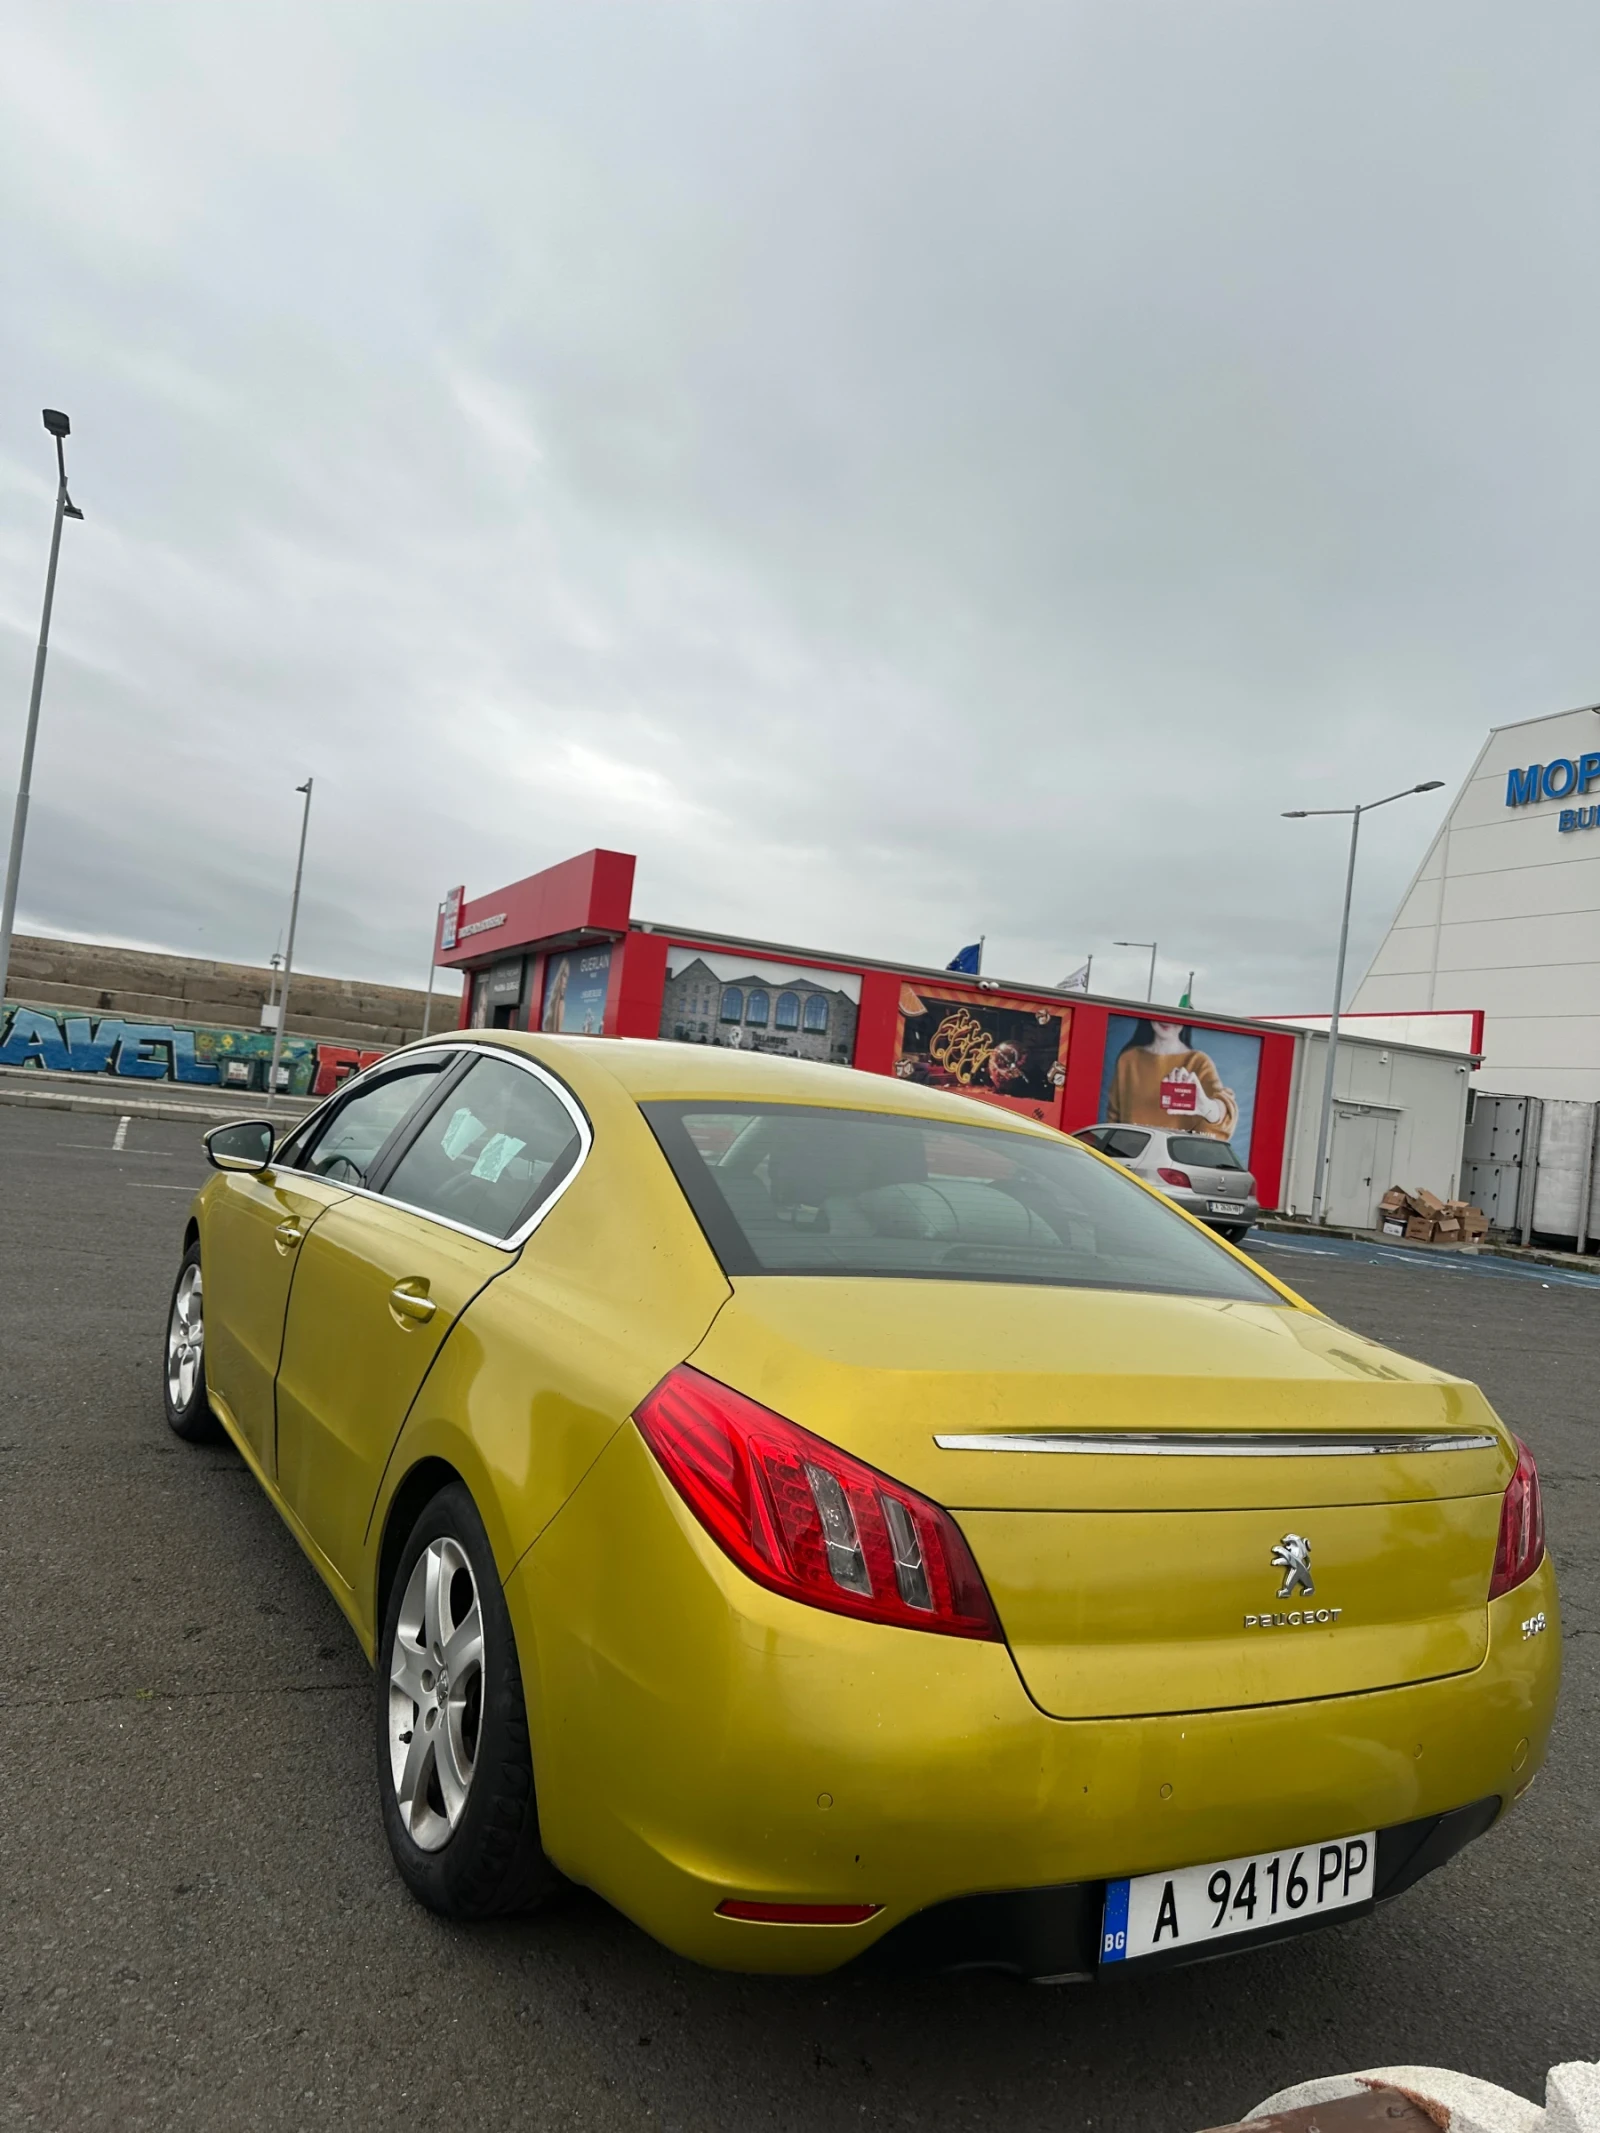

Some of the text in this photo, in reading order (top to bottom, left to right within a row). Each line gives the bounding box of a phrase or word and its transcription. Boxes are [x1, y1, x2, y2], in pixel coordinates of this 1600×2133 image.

[1558, 804, 1600, 832] BU
[1244, 1608, 1342, 1629] PEUGEOT
[1522, 1612, 1547, 1641] 508
[1152, 1880, 1179, 1943] A
[1104, 1931, 1126, 1953] BG
